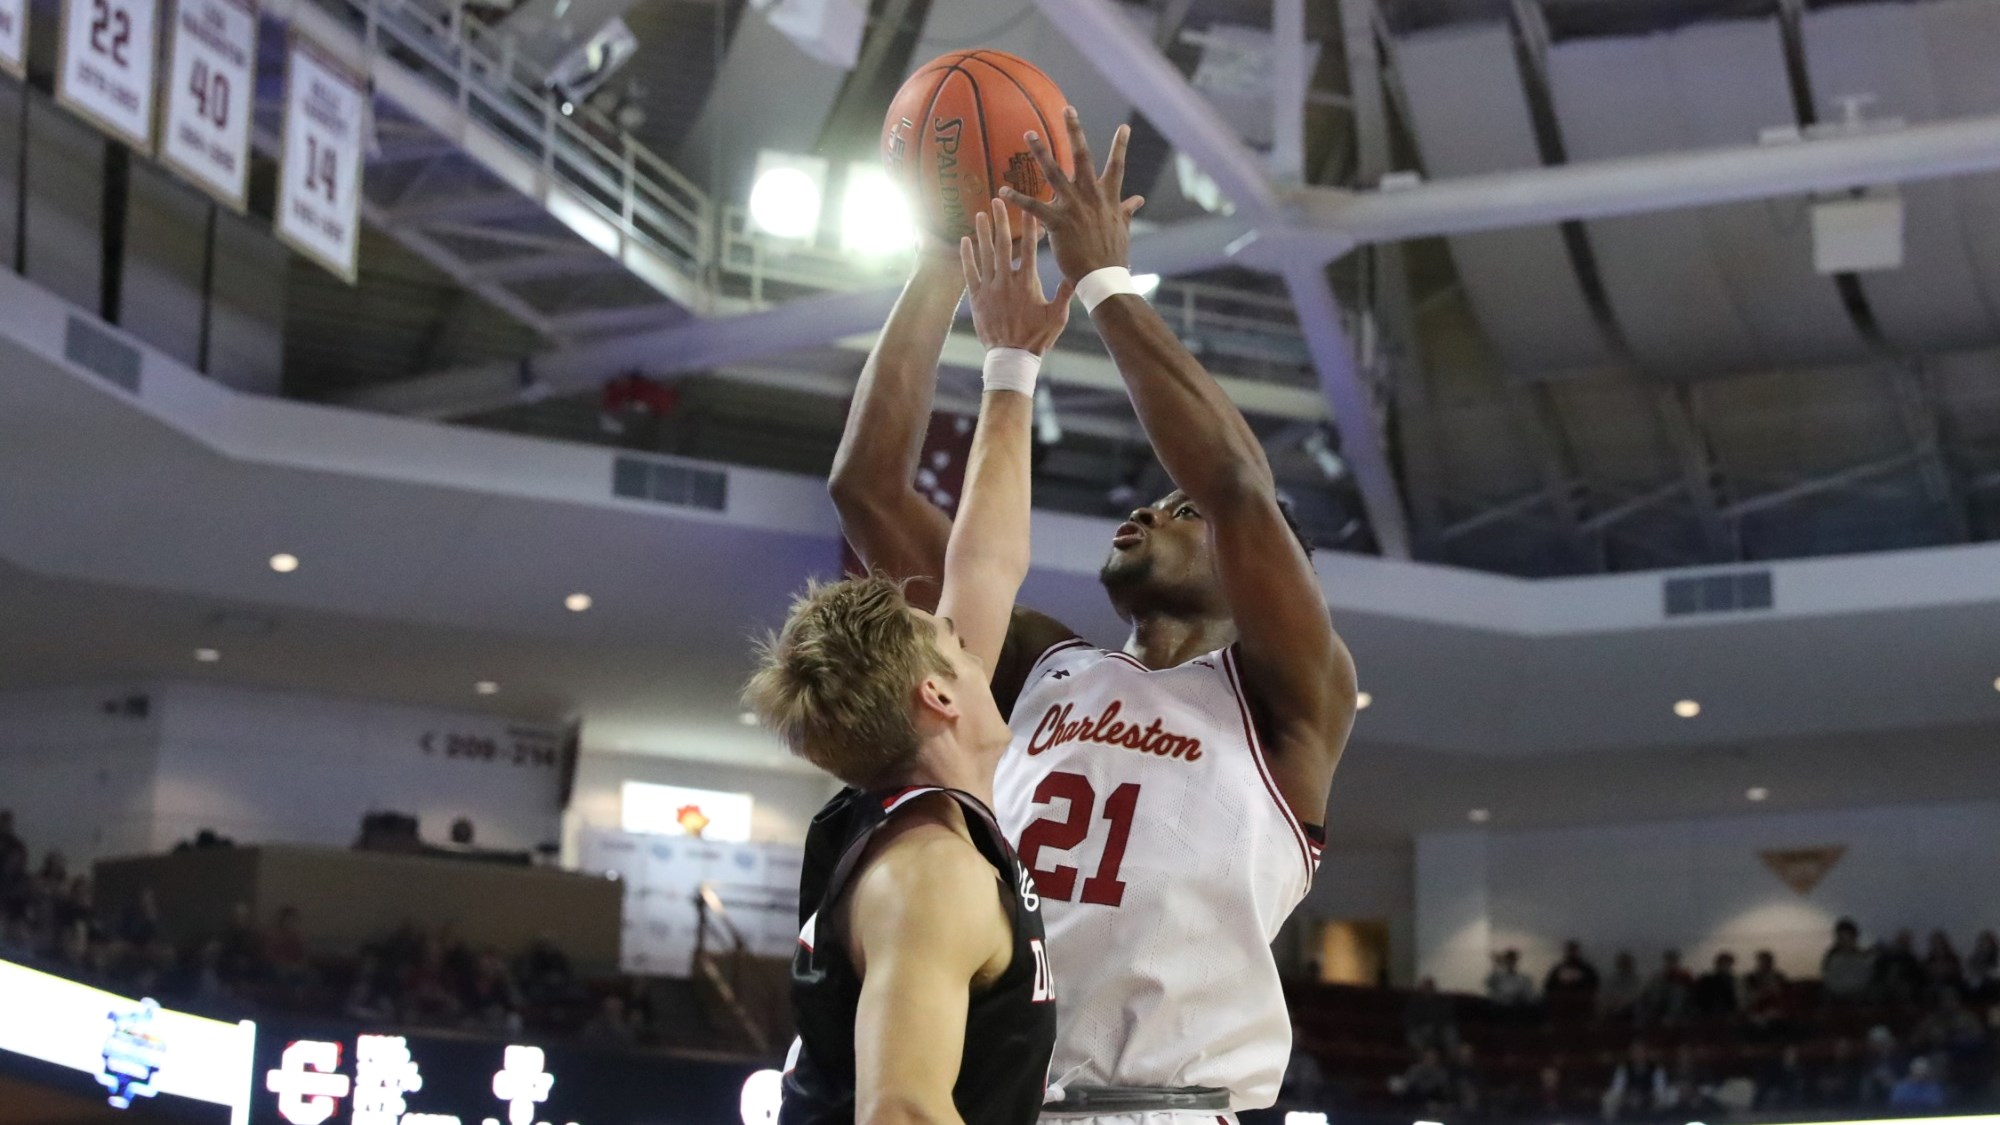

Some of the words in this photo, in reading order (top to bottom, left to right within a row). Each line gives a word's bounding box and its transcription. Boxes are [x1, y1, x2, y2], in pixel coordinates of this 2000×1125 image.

[92, 0, 130, 68] 22
[190, 58, 232, 130] 40
[305, 134, 338, 204] 14
[1027, 700, 1202, 762] Charleston
[1017, 771, 1141, 907] 21
